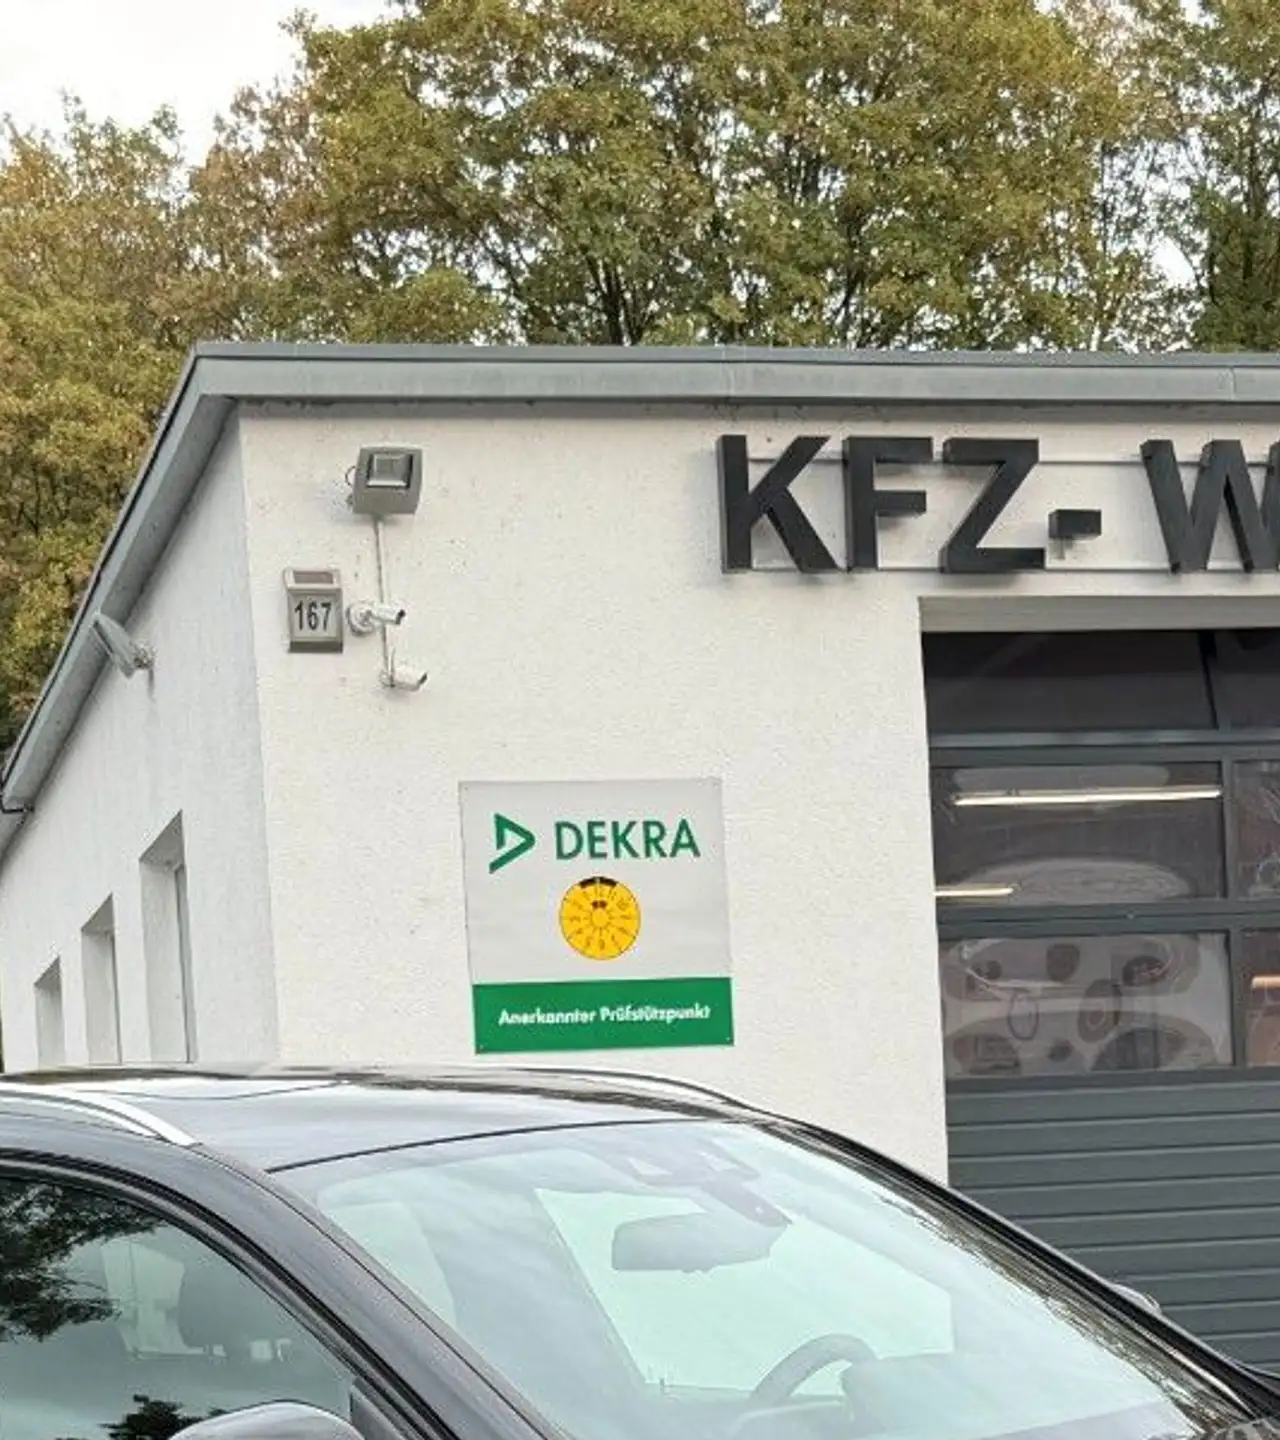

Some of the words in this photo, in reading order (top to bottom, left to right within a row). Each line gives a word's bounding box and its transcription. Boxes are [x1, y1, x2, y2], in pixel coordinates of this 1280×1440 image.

[717, 434, 1102, 573] KFZ-
[294, 600, 332, 632] 167
[554, 818, 701, 860] DEKRA
[498, 1007, 597, 1026] Anerkannter
[599, 1002, 712, 1024] Prüfstützpunkt
